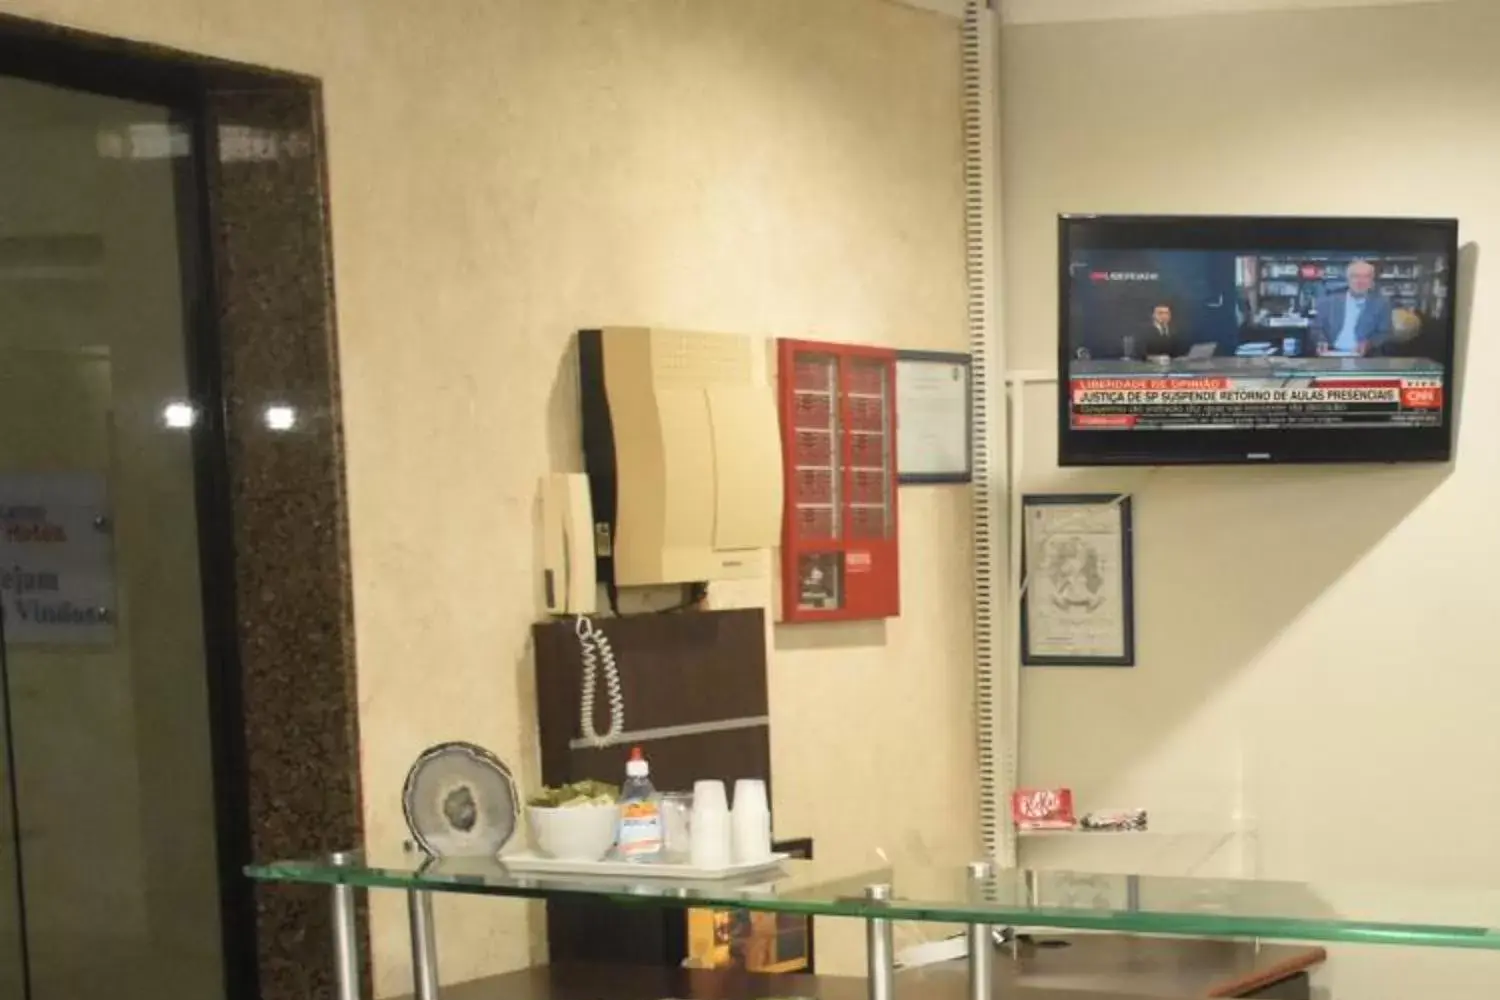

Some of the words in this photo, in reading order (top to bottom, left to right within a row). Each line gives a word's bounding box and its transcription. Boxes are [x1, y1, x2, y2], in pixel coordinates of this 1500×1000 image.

[1080, 391, 1125, 403] JUSTIÇA
[1127, 391, 1141, 401] DE
[1145, 391, 1159, 401] SP
[1161, 391, 1217, 401] SUSPENDE
[1219, 390, 1271, 401] RETORNO
[1274, 389, 1288, 400] DE
[1291, 389, 1325, 400] AULAS
[1327, 388, 1393, 400] PRESENCIAIS
